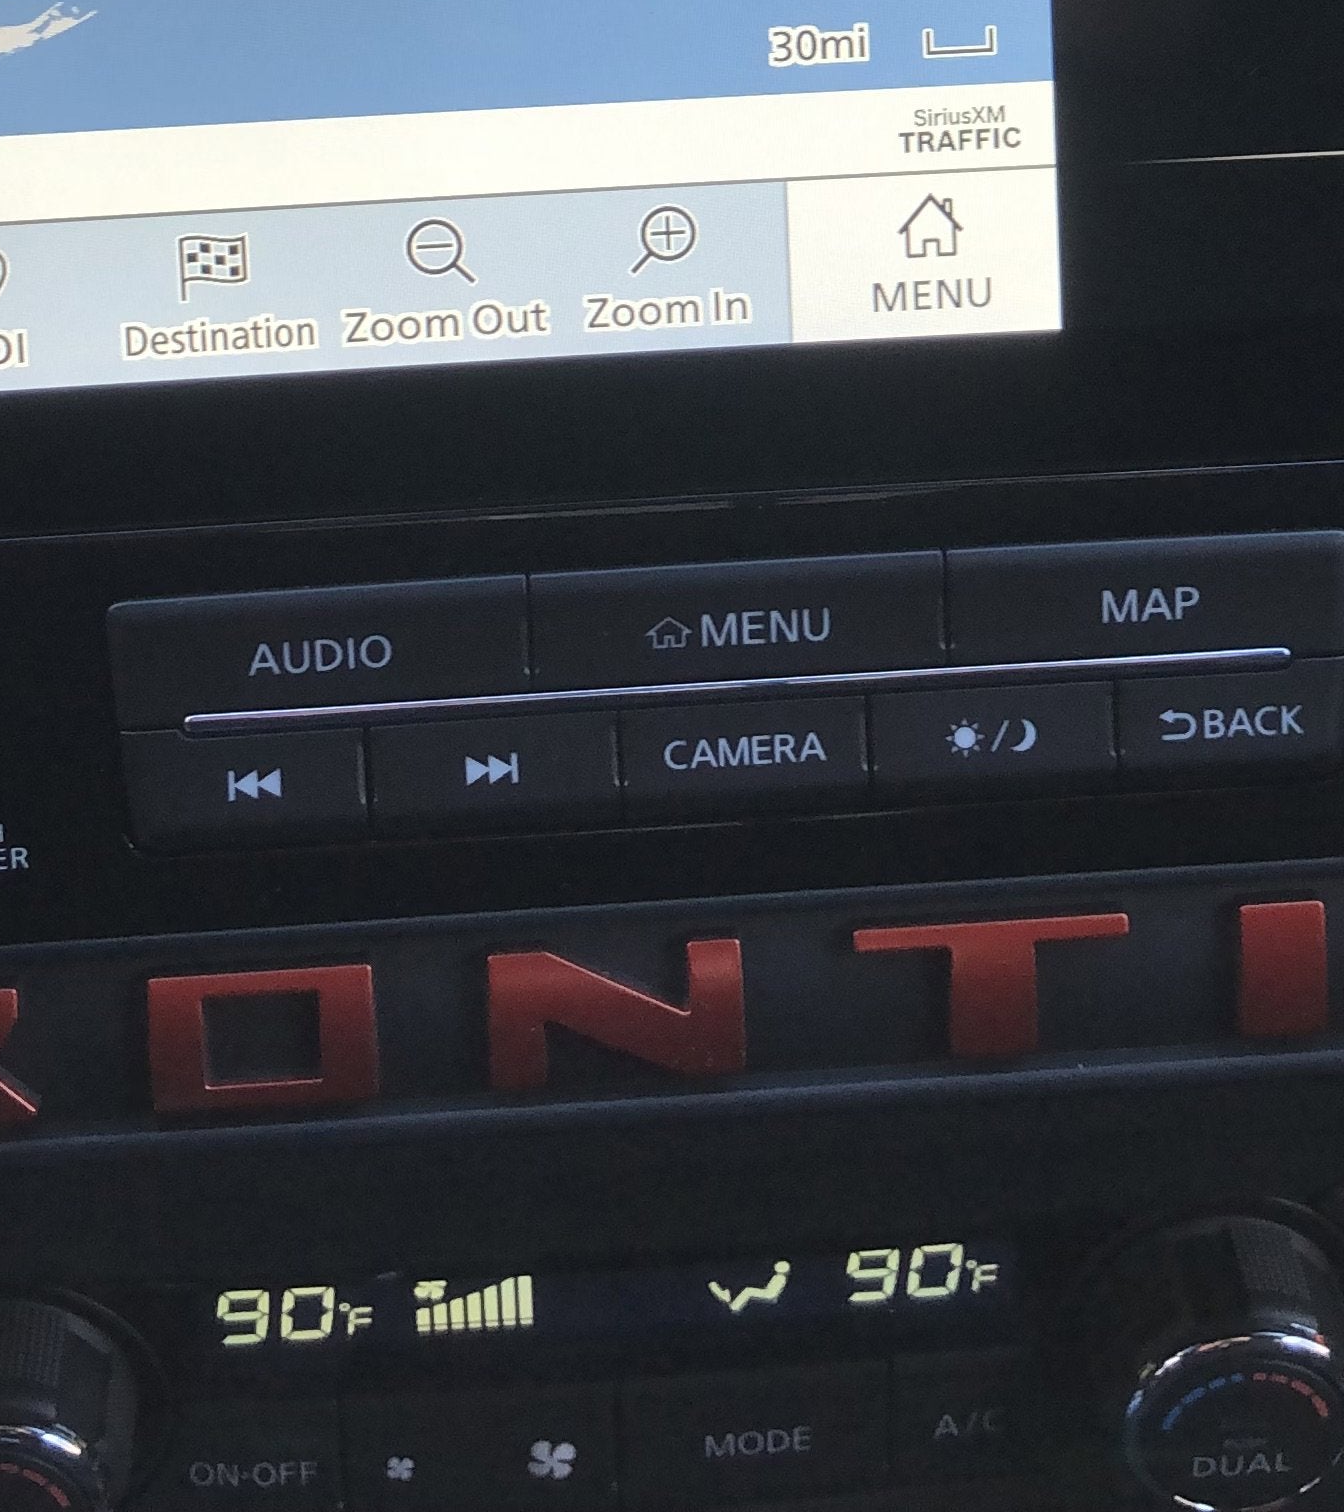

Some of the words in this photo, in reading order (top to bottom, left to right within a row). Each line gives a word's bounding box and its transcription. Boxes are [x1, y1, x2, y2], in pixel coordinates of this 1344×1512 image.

[769, 27, 868, 65] 30mi
[913, 106, 1006, 126] SiriusXM
[898, 127, 1022, 154] TRAFFIC
[585, 296, 701, 331] Zoom
[714, 292, 750, 324] In
[871, 278, 993, 313] MENU
[124, 317, 316, 358] Destination
[345, 308, 461, 344] Zoom
[474, 301, 549, 337] Out
[1101, 586, 1200, 624] MAP
[700, 608, 831, 647] MENU
[248, 634, 394, 676] AUDIO
[1202, 704, 1304, 741] BACK
[663, 733, 827, 771] CAMERA
[704, 1426, 812, 1457] MODE
[933, 1411, 1002, 1441] A/C
[1191, 1451, 1292, 1478] DUAL
